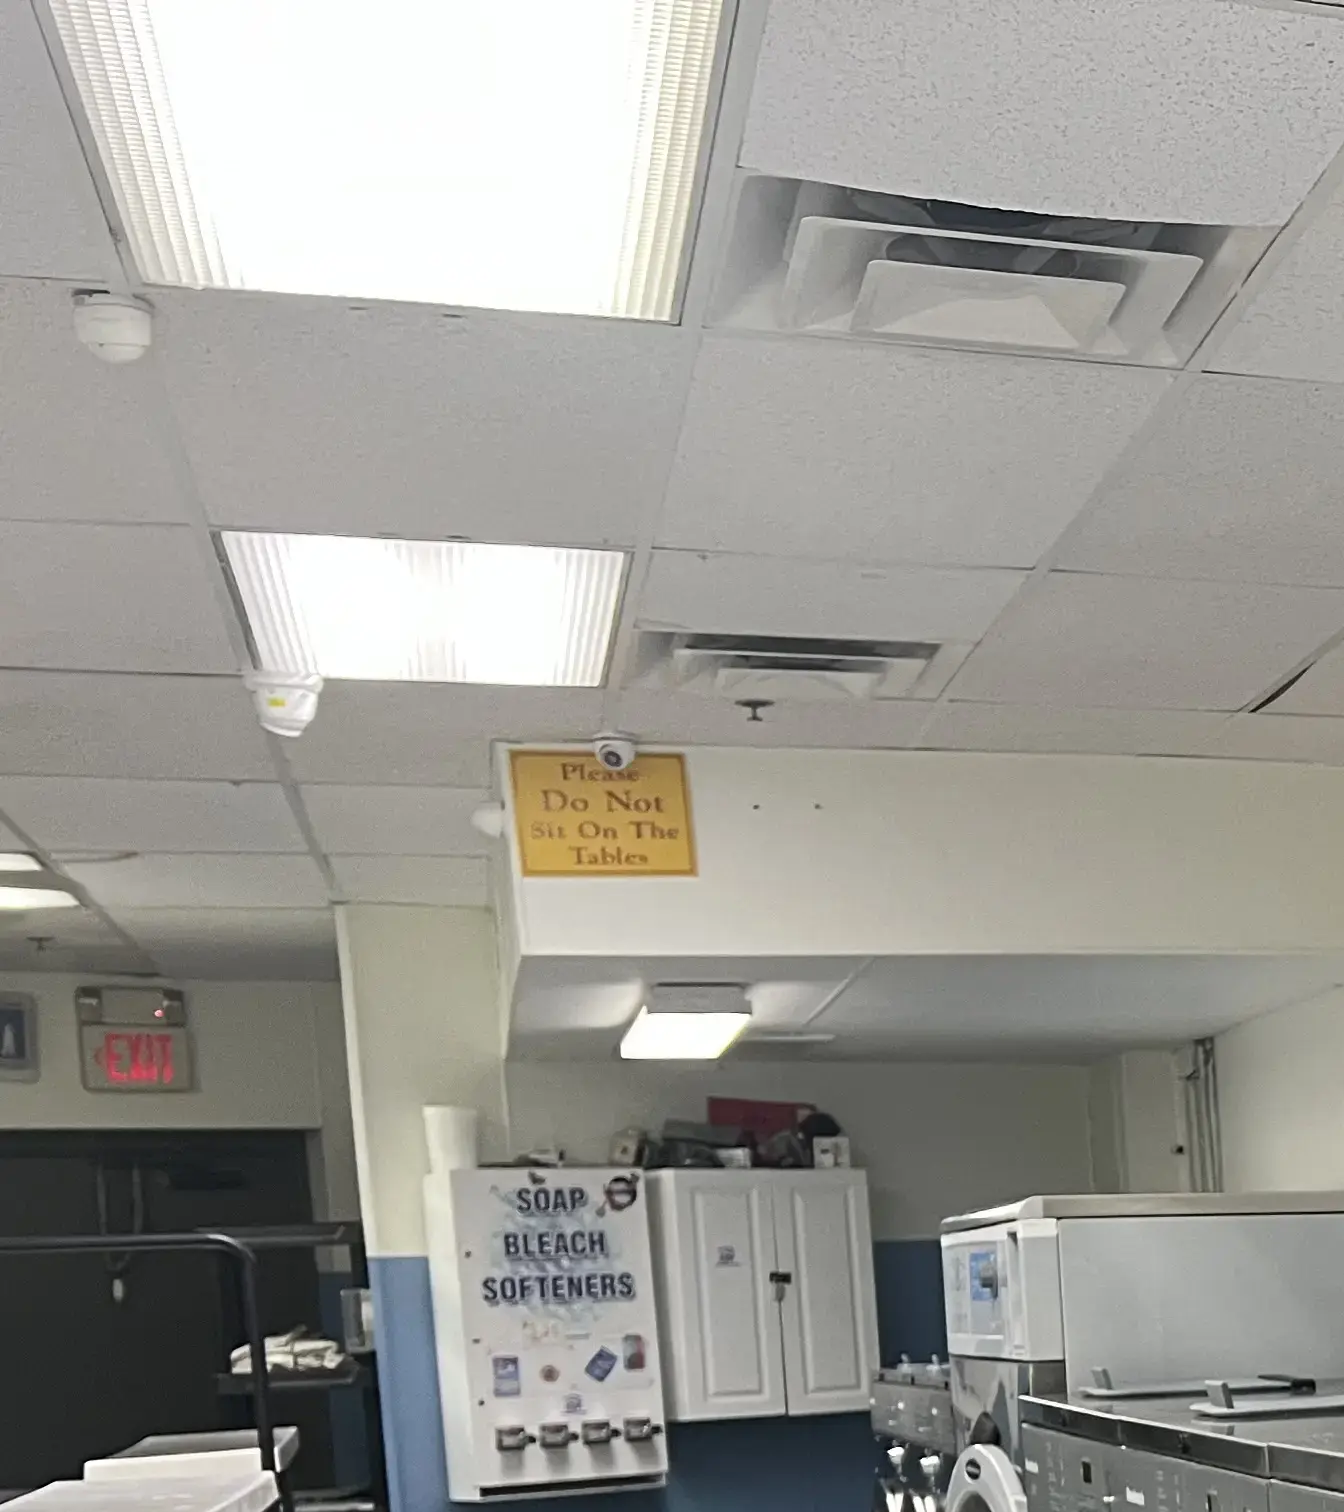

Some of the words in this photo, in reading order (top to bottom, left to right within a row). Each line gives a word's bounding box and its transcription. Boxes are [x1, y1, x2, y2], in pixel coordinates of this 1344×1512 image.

[561, 763, 641, 782] Please
[541, 789, 589, 813] Do
[605, 789, 665, 813] Not
[531, 821, 567, 840] Sit
[577, 821, 618, 840] On
[628, 821, 680, 840] The
[568, 846, 648, 866] Tables
[515, 1187, 587, 1214] SOAP
[503, 1230, 609, 1258] BLEACH
[482, 1271, 635, 1301] SOFTENERS
